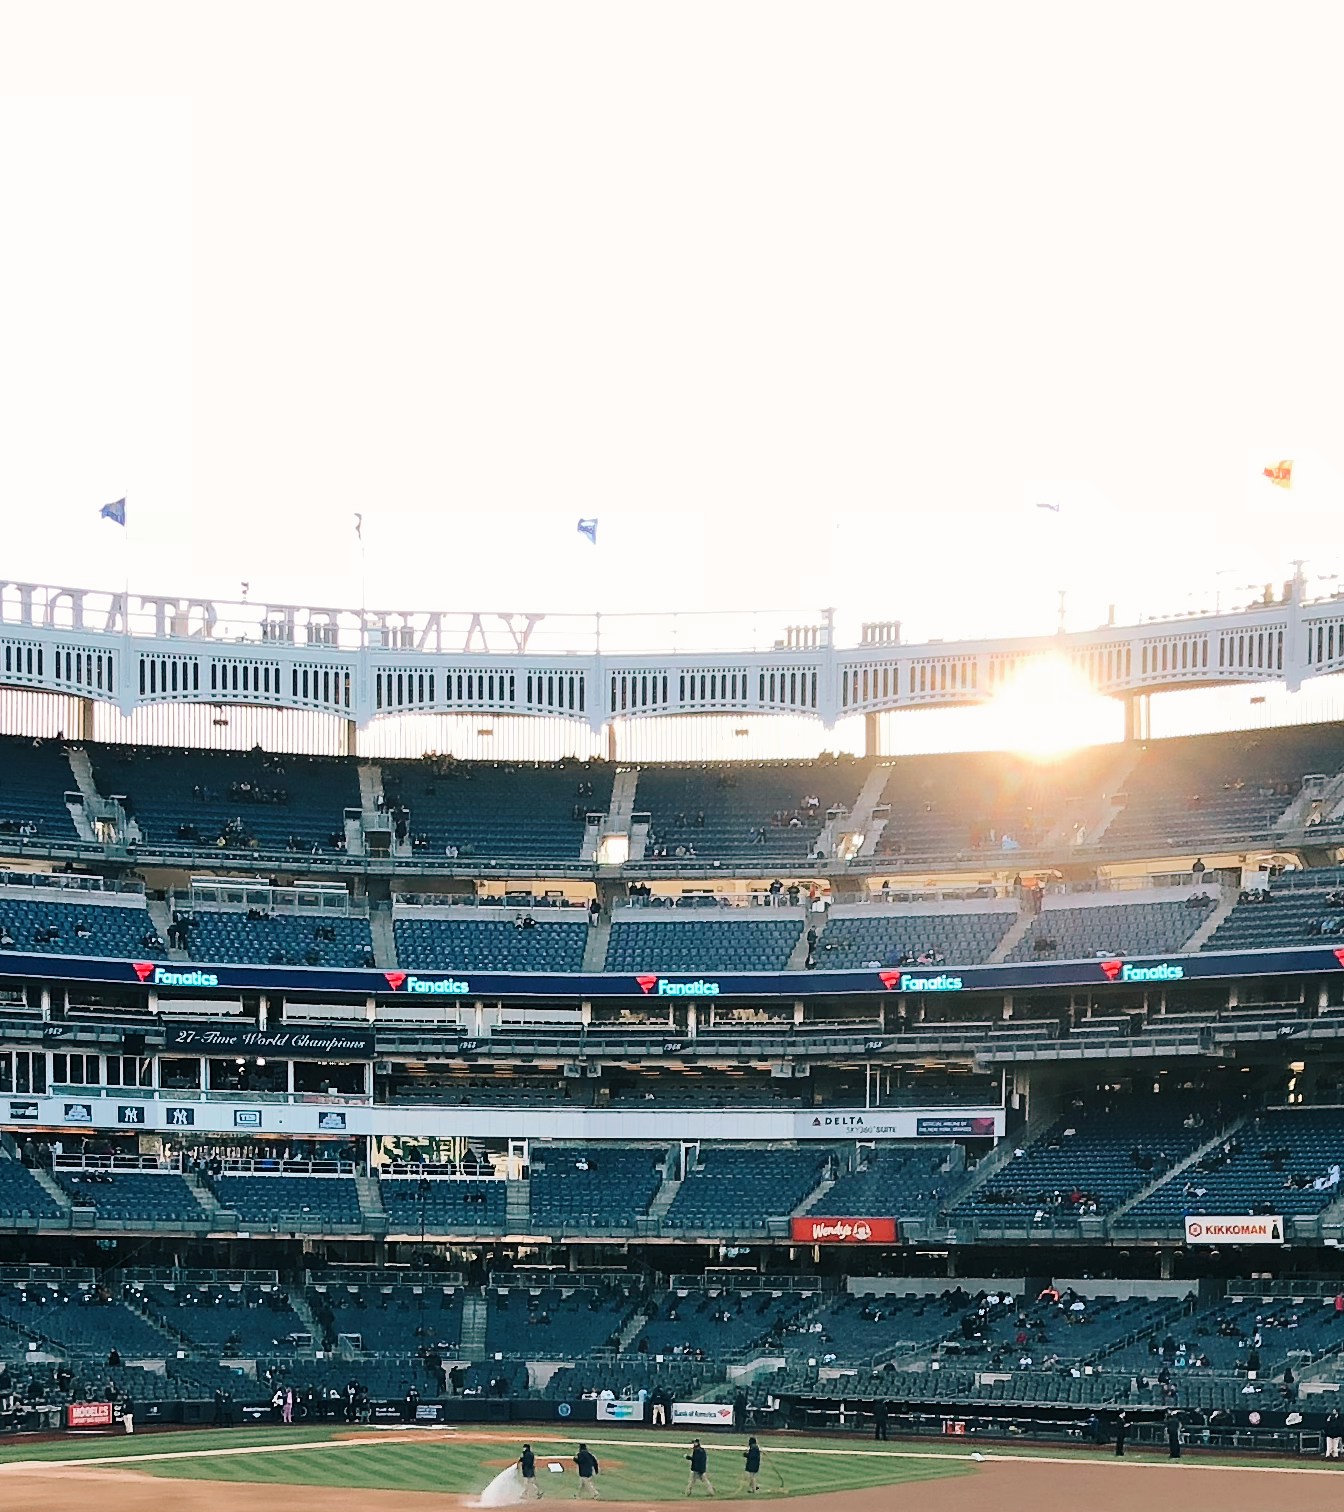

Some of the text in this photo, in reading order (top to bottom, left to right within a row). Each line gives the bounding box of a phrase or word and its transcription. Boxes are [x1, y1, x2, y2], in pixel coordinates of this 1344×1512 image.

[155, 968, 219, 986] Fanatics
[1123, 963, 1184, 981] Fanatics
[408, 976, 470, 993] Fanatics
[658, 979, 720, 995] Fanatics
[901, 975, 963, 991] Fanatics
[175, 1030, 366, 1052] 27-Time World Champions
[824, 1116, 864, 1126] DELTA
[812, 1220, 853, 1240] Wendy's
[1205, 1224, 1268, 1235] KIKKOMAN
